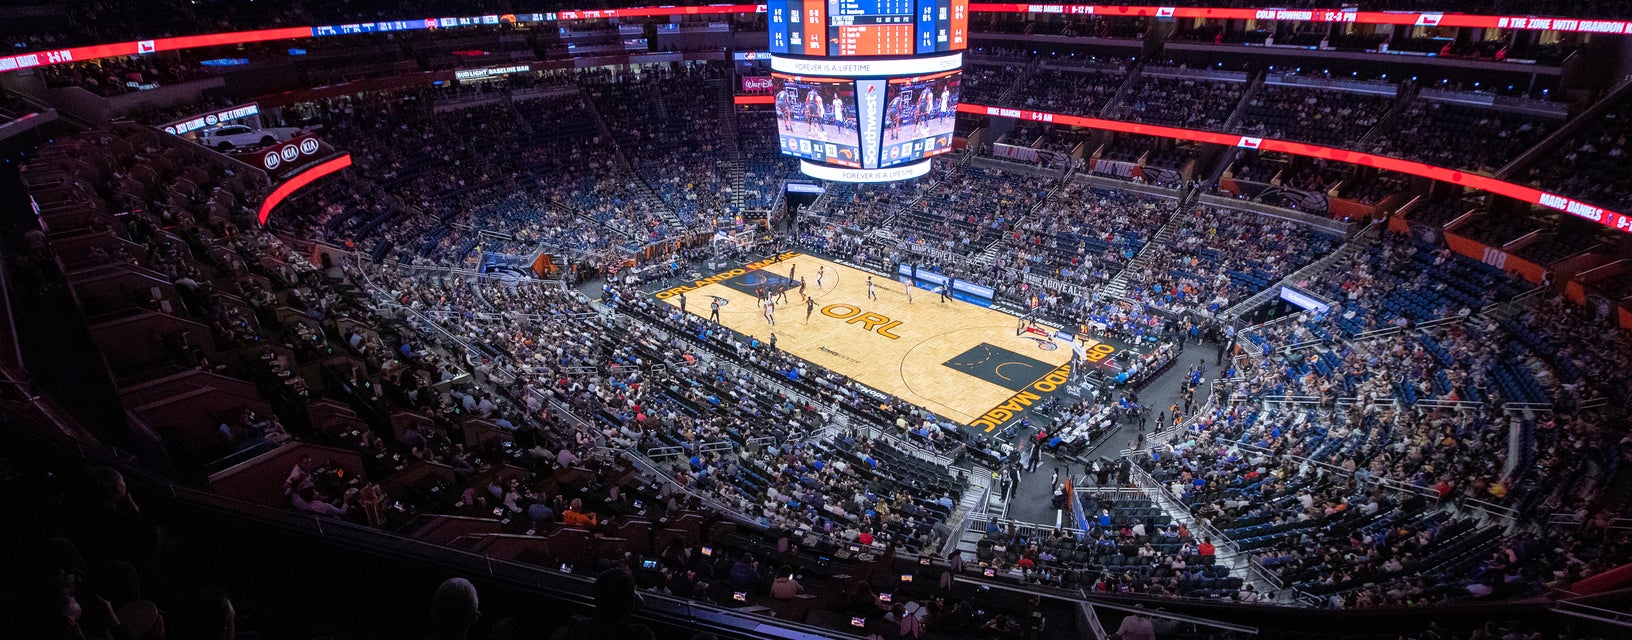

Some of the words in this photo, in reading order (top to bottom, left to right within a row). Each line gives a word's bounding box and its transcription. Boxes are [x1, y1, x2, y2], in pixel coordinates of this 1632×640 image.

[1325, 12, 1342, 21] 12-3
[1343, 13, 1357, 22] PM
[1510, 18, 1528, 29] THE
[1527, 18, 1553, 30] ZONE
[1552, 19, 1580, 31] WITH
[1578, 20, 1624, 33] BRANDON
[46, 51, 61, 63] 3-6
[60, 50, 73, 62] PM
[470, 69, 487, 77] LIGHT
[488, 67, 517, 75] BASELINE
[795, 63, 822, 71] FOREVER
[824, 64, 830, 72] IS
[839, 64, 871, 72] LIFETIME
[1032, 112, 1043, 121] 6-9
[1043, 113, 1053, 122] AM
[864, 94, 877, 165] Southwest
[302, 140, 316, 152] KIA
[283, 147, 297, 160] KIA
[266, 154, 279, 167] KIA
[842, 171, 873, 180] FOREVER
[1539, 193, 1568, 210] MARC
[1567, 200, 1603, 222] DANIELS
[1482, 247, 1507, 269] 108
[656, 268, 746, 300] ORLANDO
[1042, 278, 1069, 293] ABOVE
[821, 303, 903, 340] ORL
[970, 391, 1042, 433] MAGIC
